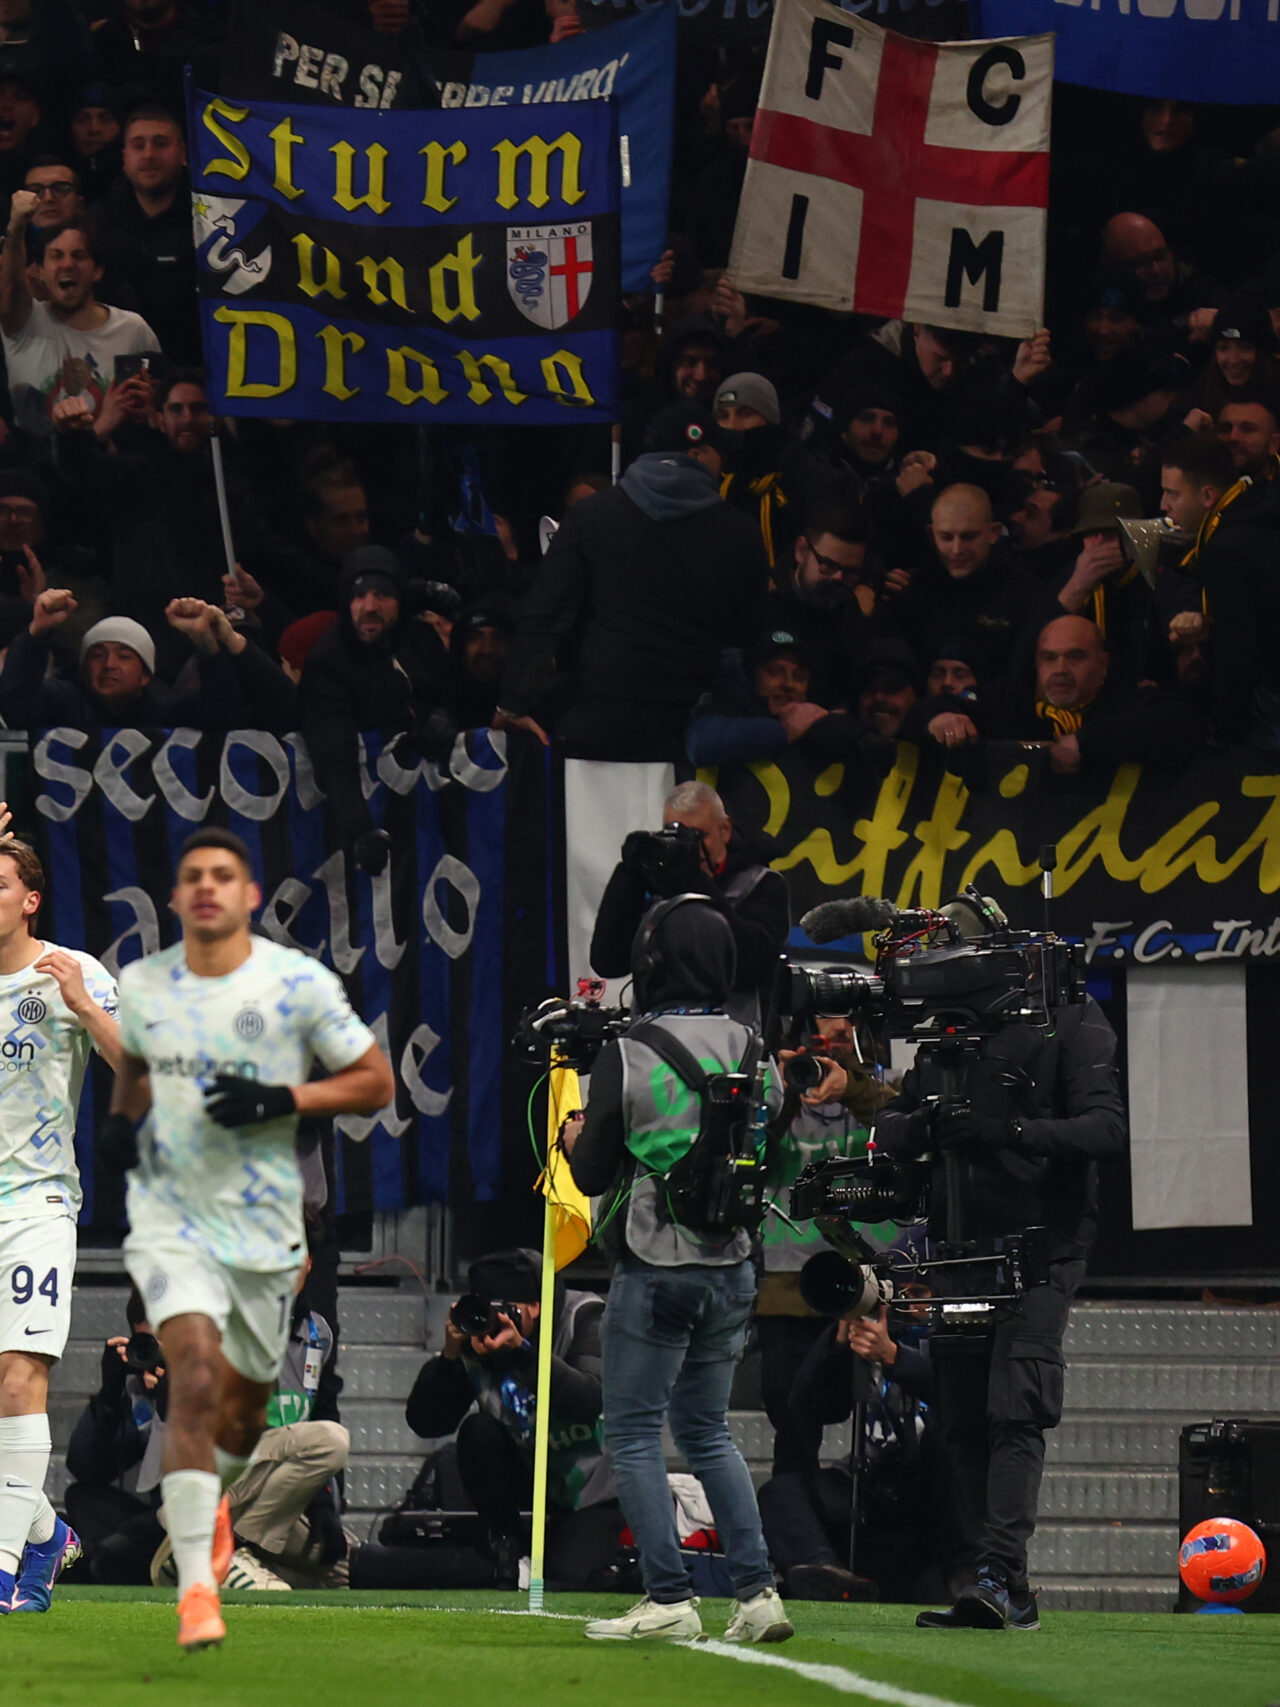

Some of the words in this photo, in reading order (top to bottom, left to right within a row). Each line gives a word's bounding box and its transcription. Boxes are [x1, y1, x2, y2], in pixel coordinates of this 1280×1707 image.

[272, 30, 350, 101] PER
[806, 17, 857, 100] F
[967, 46, 1026, 126] C
[201, 97, 587, 214] Sturm
[292, 231, 484, 324] und
[511, 225, 587, 239] MILANO
[782, 194, 809, 280] I
[945, 228, 1005, 312] M
[214, 306, 595, 407] Drang
[11, 1265, 59, 1307] 94
